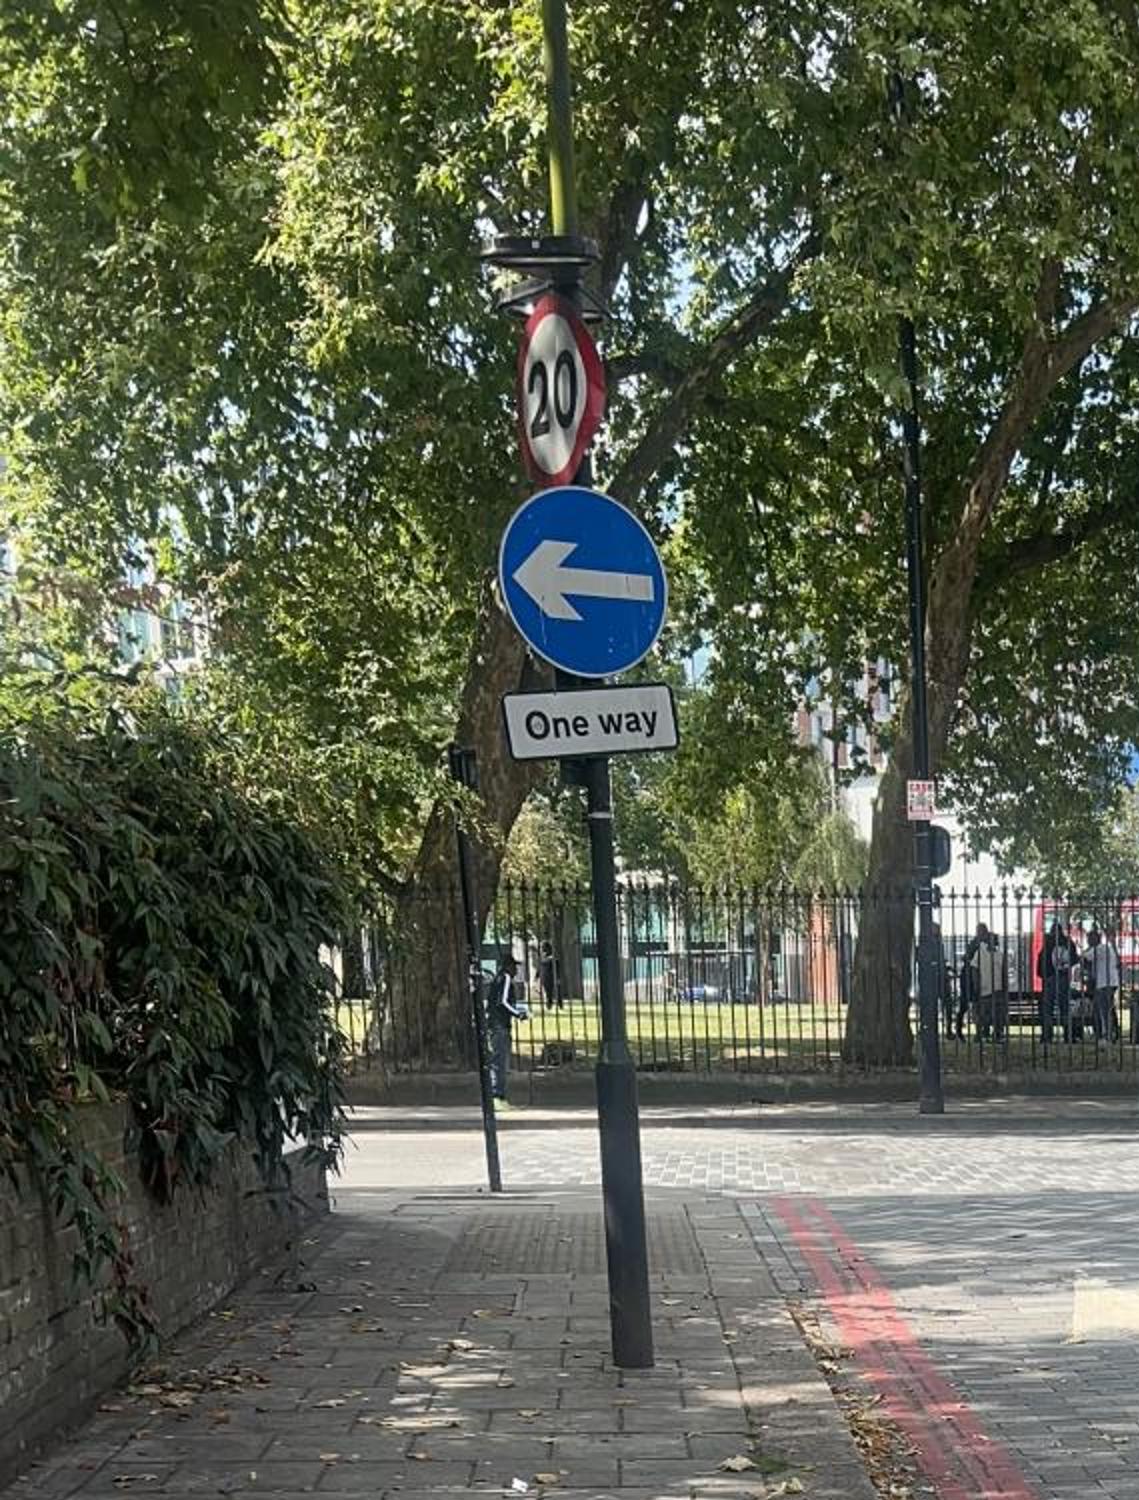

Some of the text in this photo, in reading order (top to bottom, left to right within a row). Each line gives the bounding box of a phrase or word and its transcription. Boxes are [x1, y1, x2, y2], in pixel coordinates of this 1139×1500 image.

[528, 350, 577, 439] 20
[525, 710, 658, 740] One way
